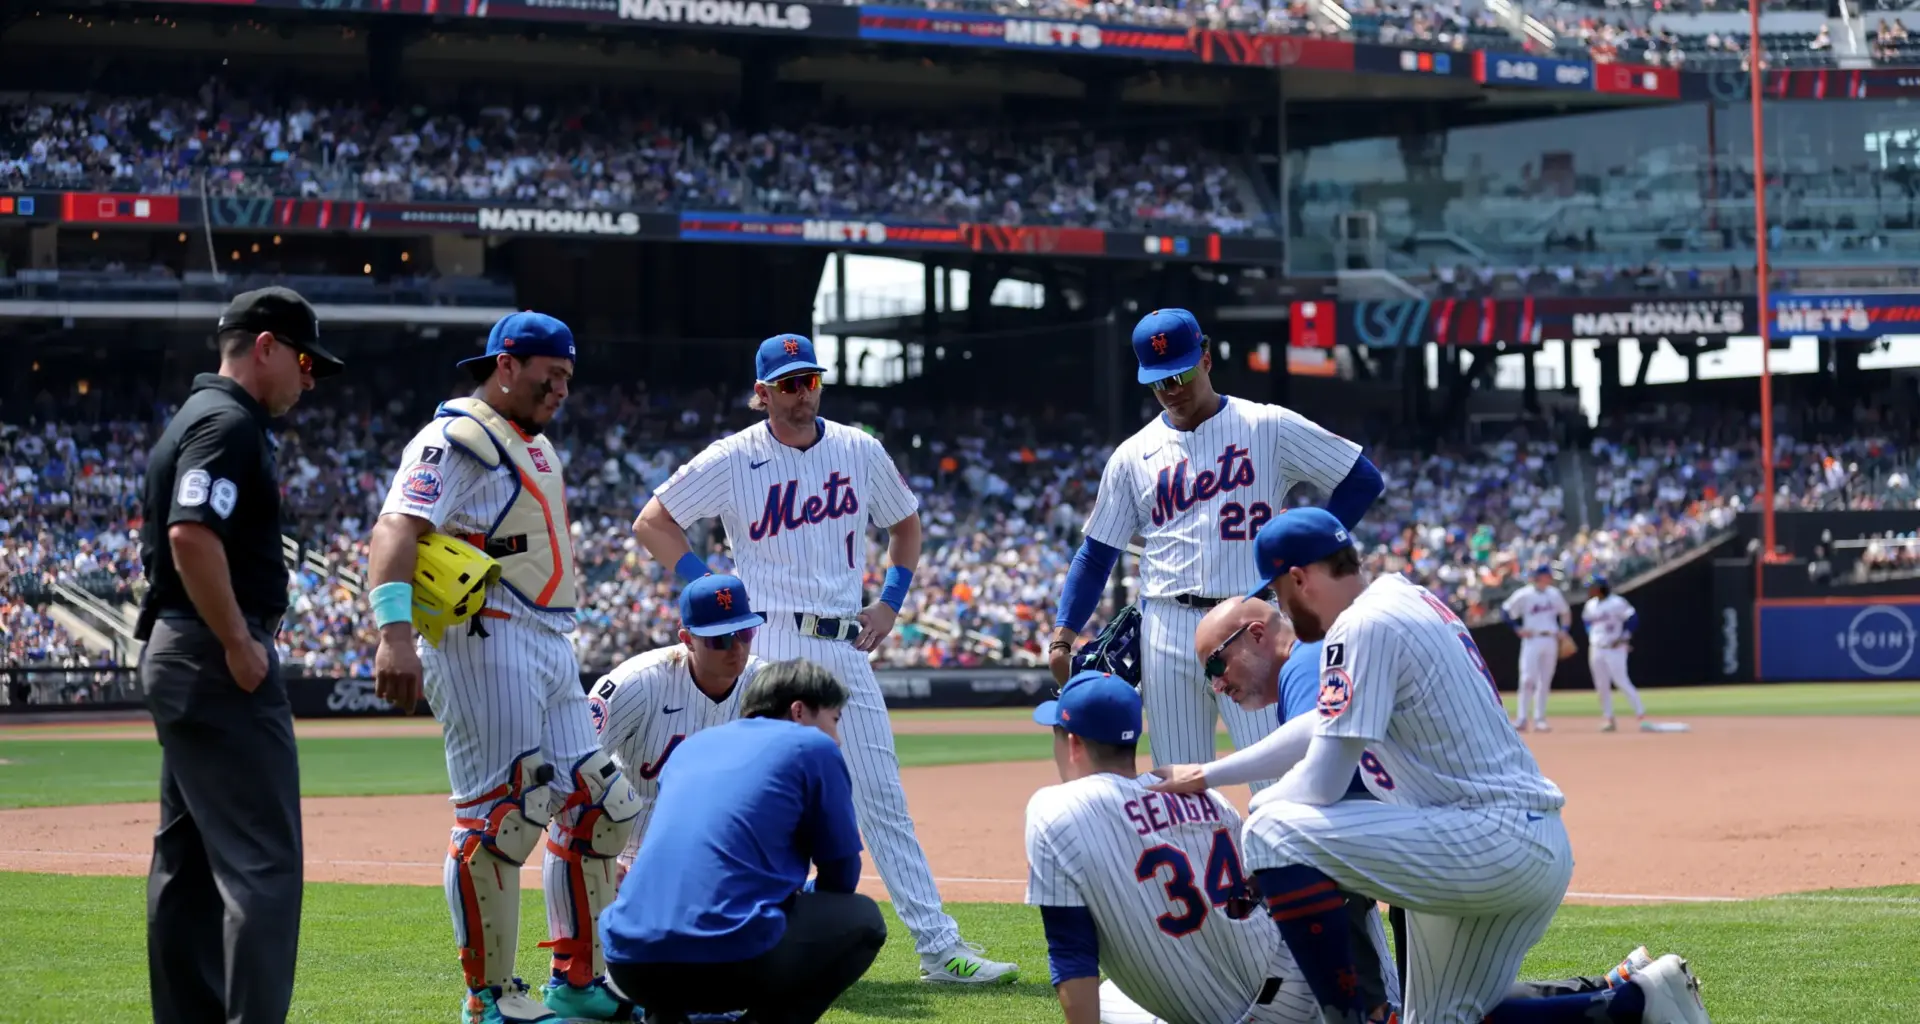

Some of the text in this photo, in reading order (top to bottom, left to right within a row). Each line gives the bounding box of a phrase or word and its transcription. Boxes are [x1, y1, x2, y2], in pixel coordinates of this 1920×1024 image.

[617, 0, 812, 30] NATIONALS
[1005, 18, 1101, 49] METS
[478, 207, 640, 235] NATIONALS
[804, 219, 886, 243] METS
[1572, 311, 1744, 336] NATIONALS
[1776, 306, 1870, 333] METS
[424, 447, 438, 462] 7
[1151, 443, 1256, 527] Mets
[749, 471, 859, 541] Mets
[1219, 501, 1273, 541] 22
[845, 529, 856, 570] 1
[1329, 647, 1339, 665] 7
[600, 681, 613, 695] 7
[1124, 791, 1220, 836] SENGA
[1134, 828, 1250, 939] 34
